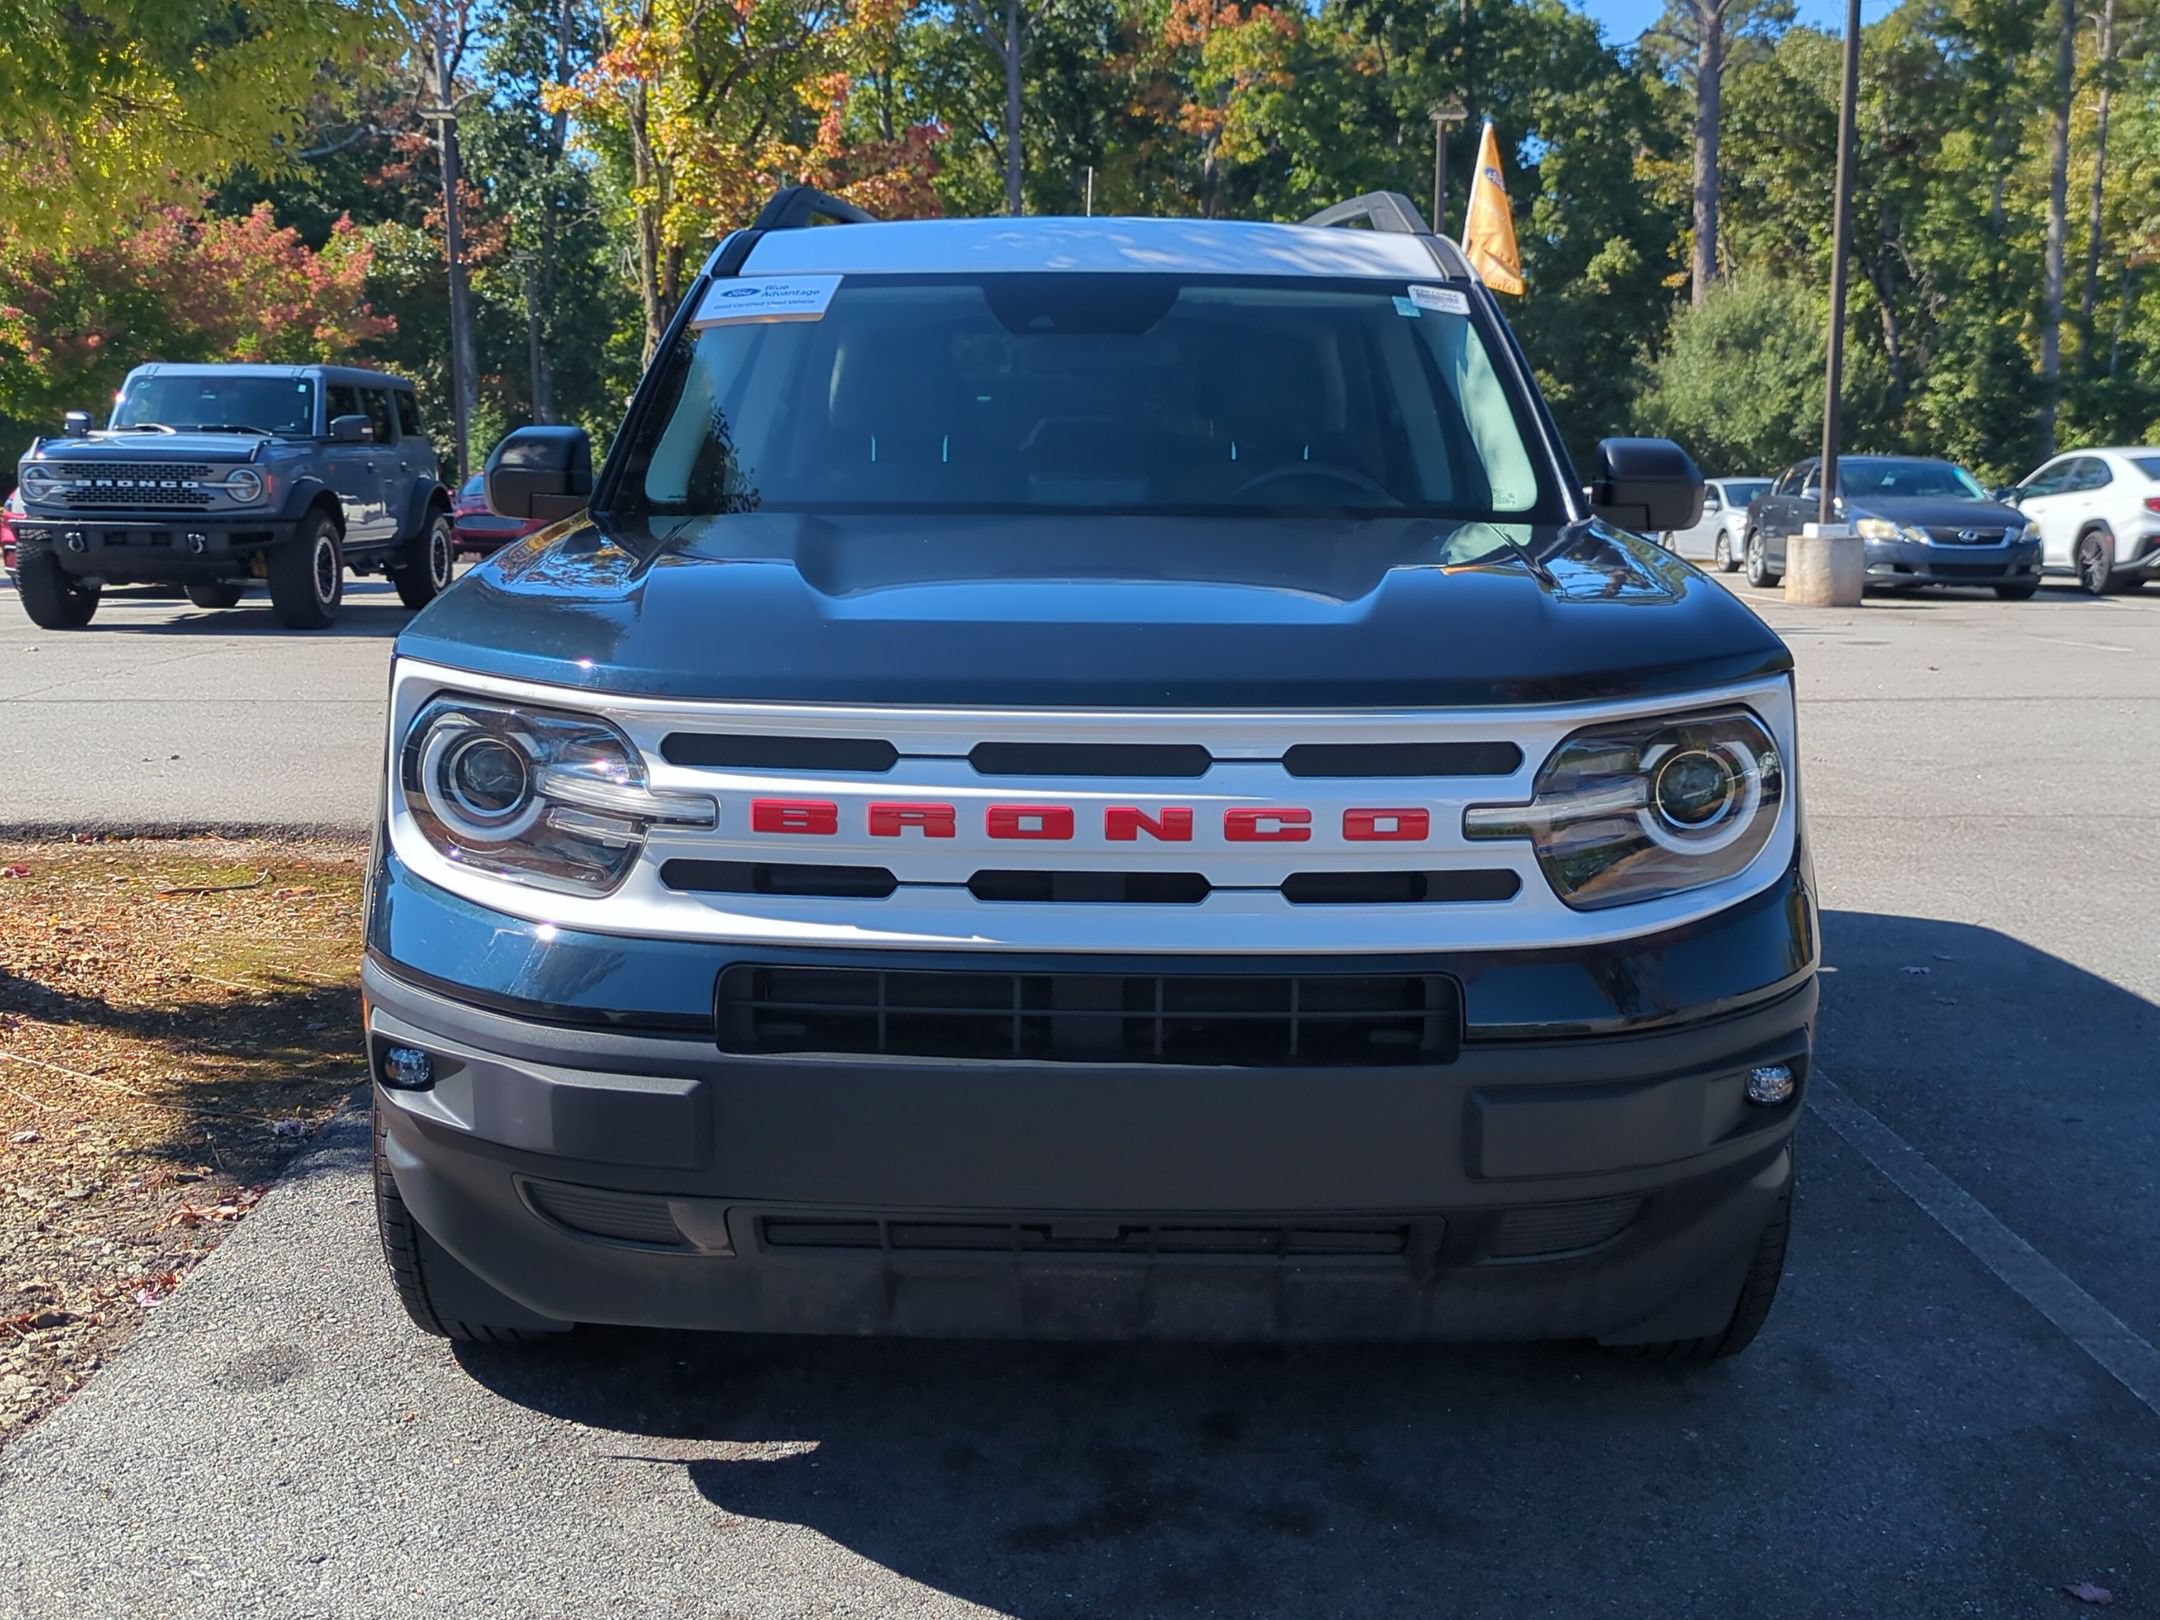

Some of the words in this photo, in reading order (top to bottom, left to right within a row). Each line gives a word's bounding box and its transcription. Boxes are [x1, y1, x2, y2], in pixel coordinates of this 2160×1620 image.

[761, 289, 821, 298] Advantage
[75, 479, 200, 488] BRONCO
[750, 798, 1430, 842] BRONCO
